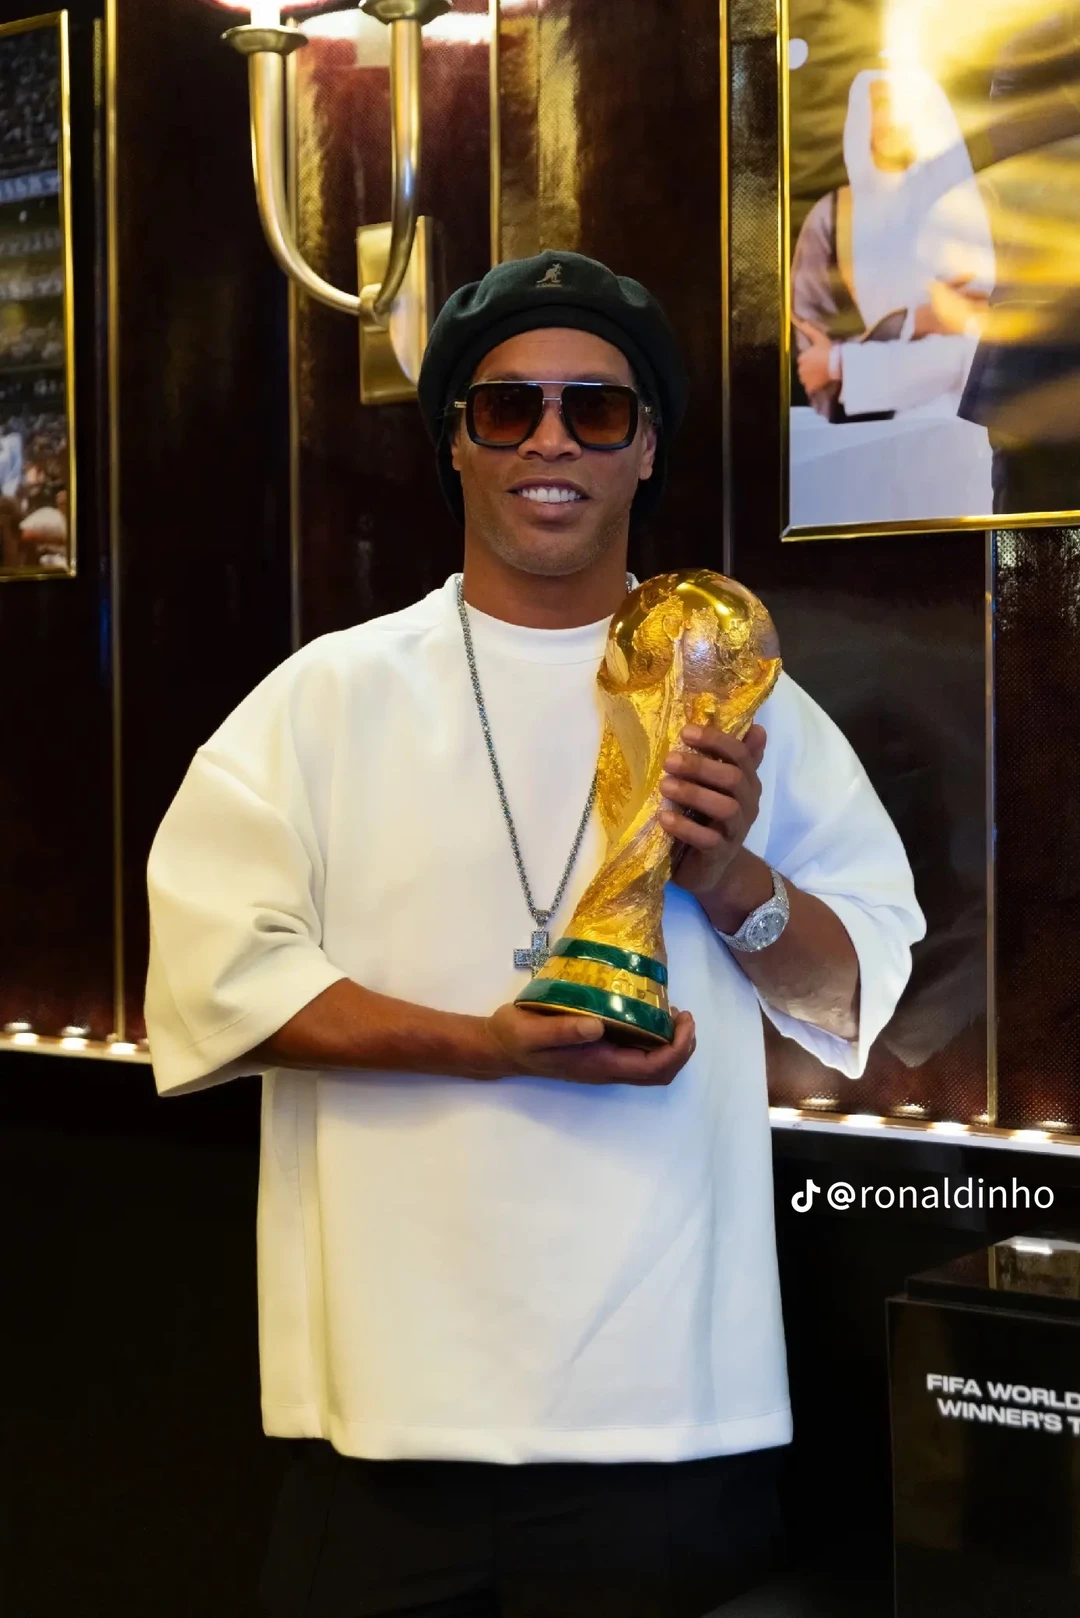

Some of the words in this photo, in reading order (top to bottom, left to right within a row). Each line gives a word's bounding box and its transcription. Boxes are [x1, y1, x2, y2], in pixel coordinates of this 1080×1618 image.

[926, 1373, 982, 1397] FIFA
[986, 1381, 1080, 1410] WORLD
[936, 1398, 1063, 1433] WINNER'S
